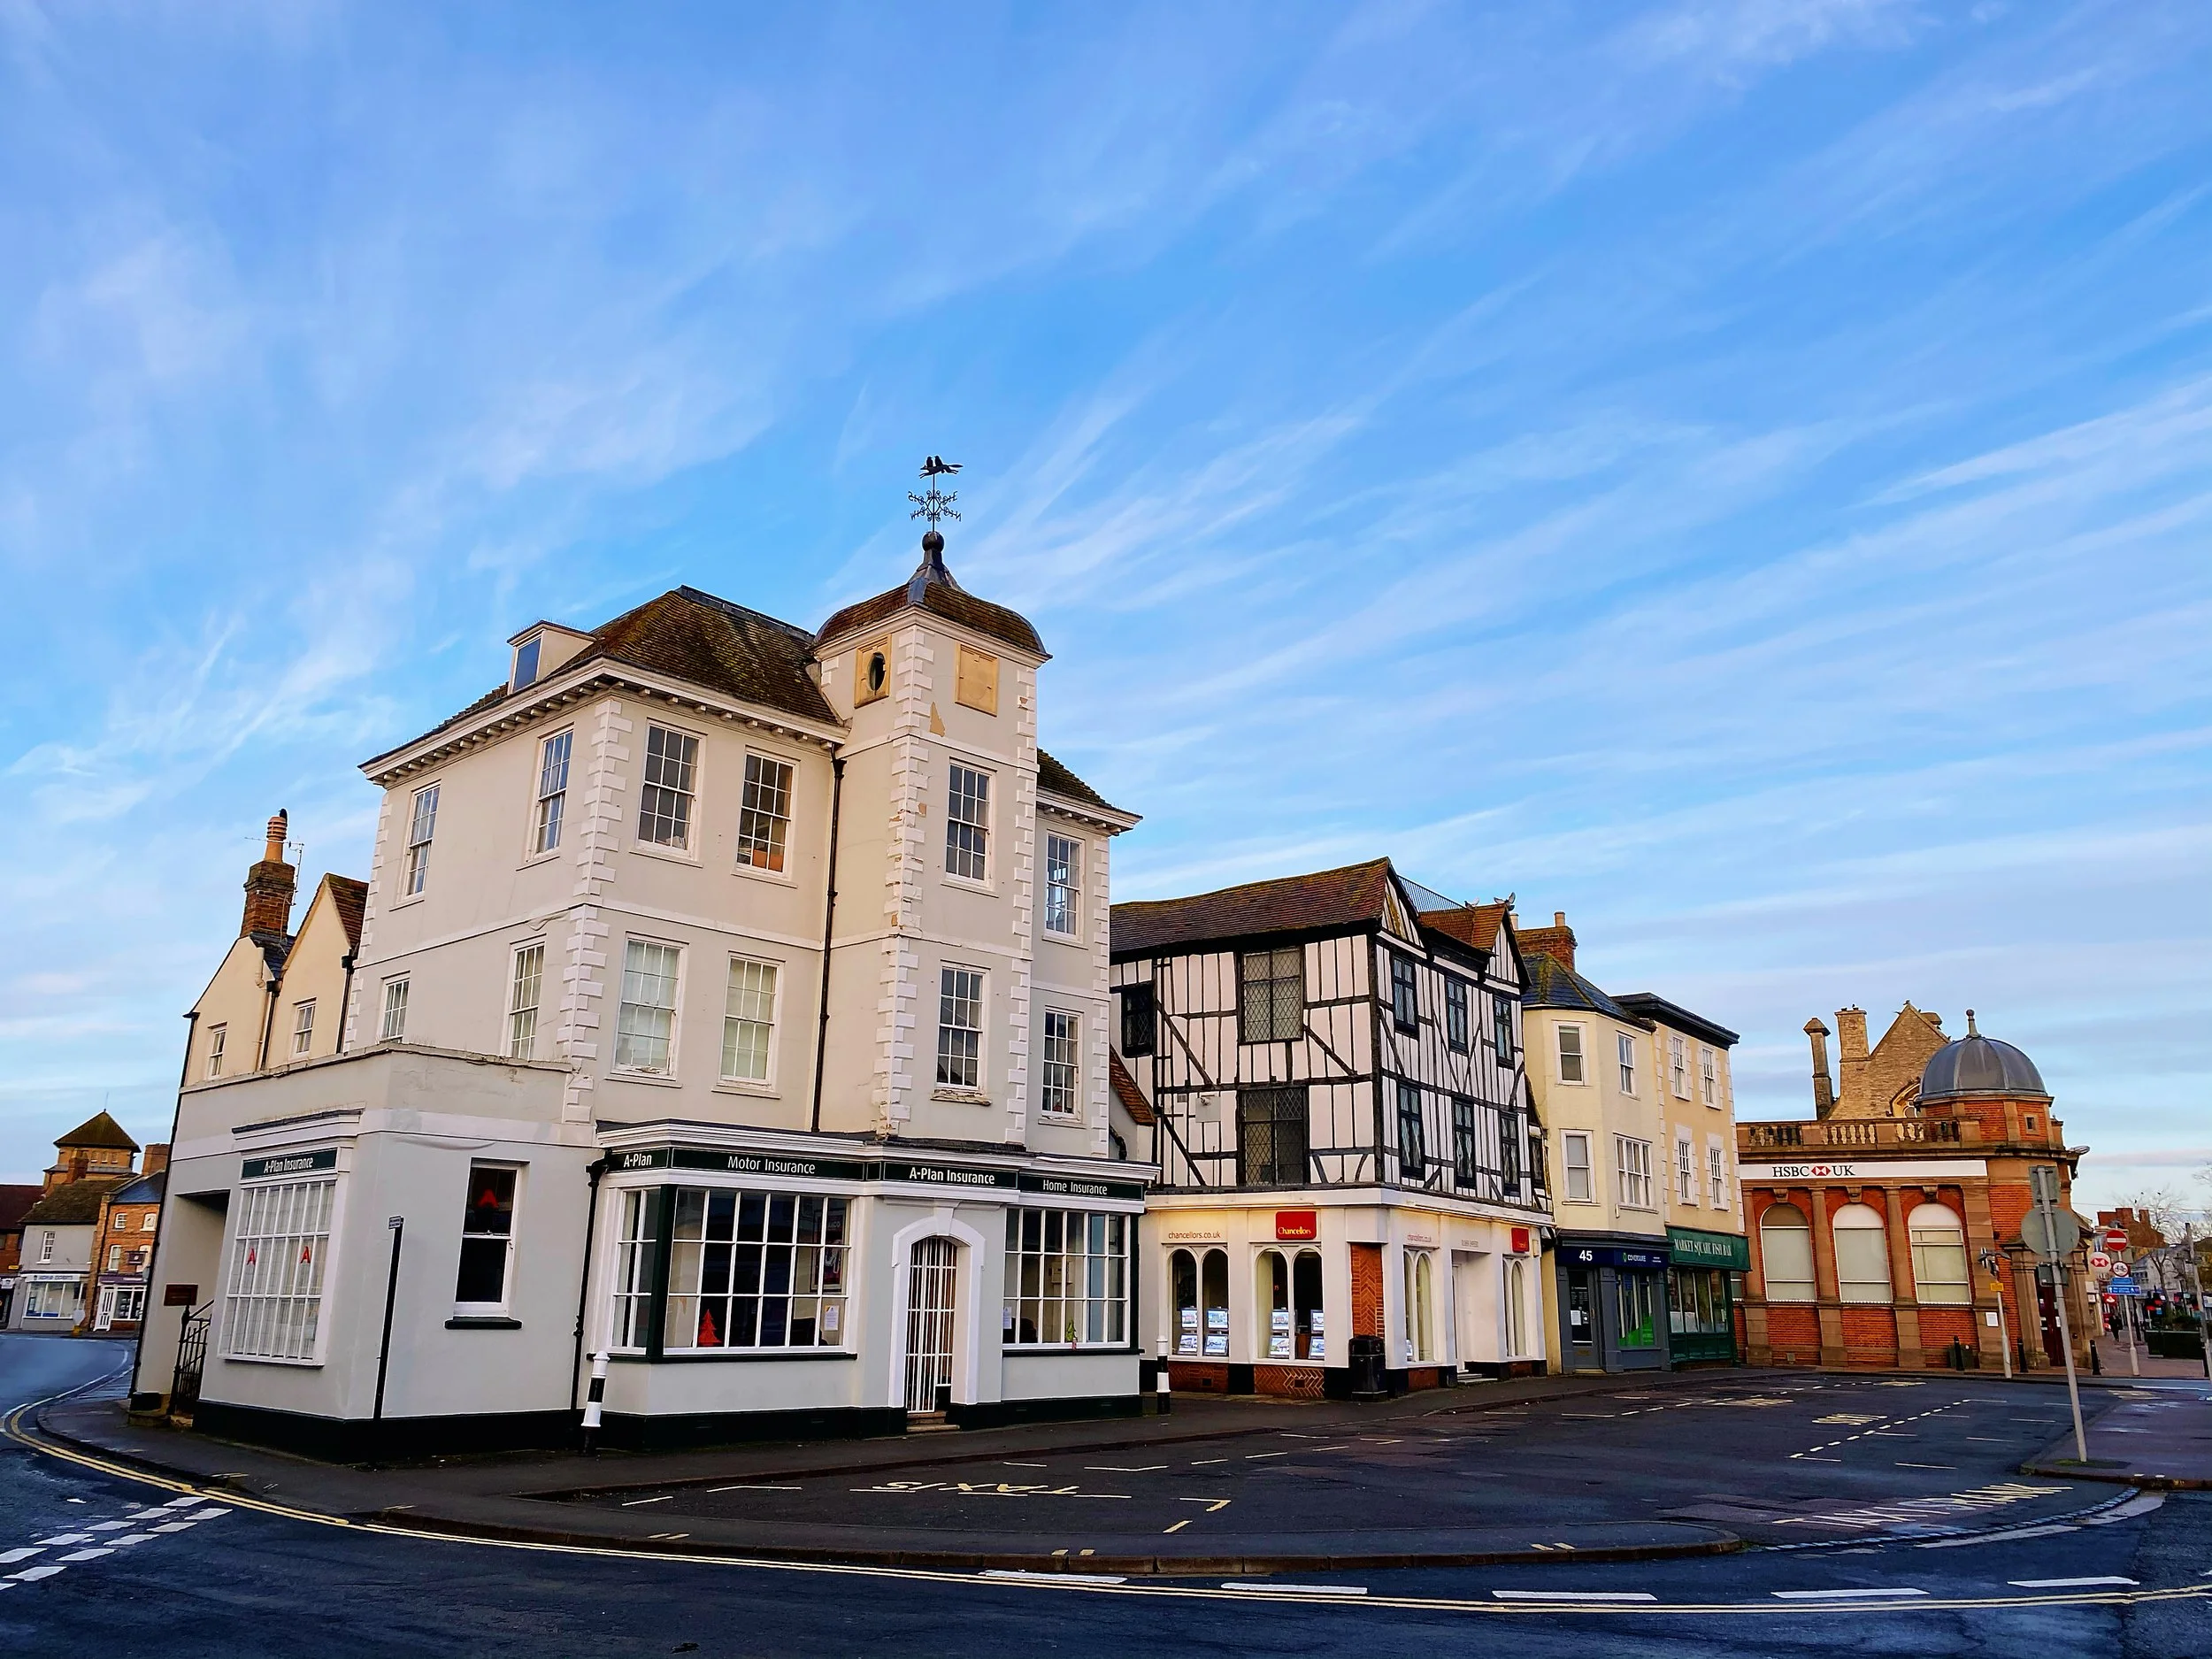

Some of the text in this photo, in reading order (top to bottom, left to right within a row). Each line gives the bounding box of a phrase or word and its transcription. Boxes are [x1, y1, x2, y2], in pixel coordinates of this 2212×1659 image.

[263, 1156, 314, 1174] A-Plan Insurance
[623, 1153, 652, 1168] A-Plan
[727, 1156, 816, 1174] Motor Insurance
[909, 1166, 995, 1185] A-Plan Insurance
[1772, 1164, 1856, 1178] HSBC UK
[1042, 1179, 1108, 1195] Home Insurance
[1278, 1225, 1312, 1235] Chancellors
[1578, 1249, 1594, 1262] 45
[872, 1481, 1079, 1494] TAXIS
